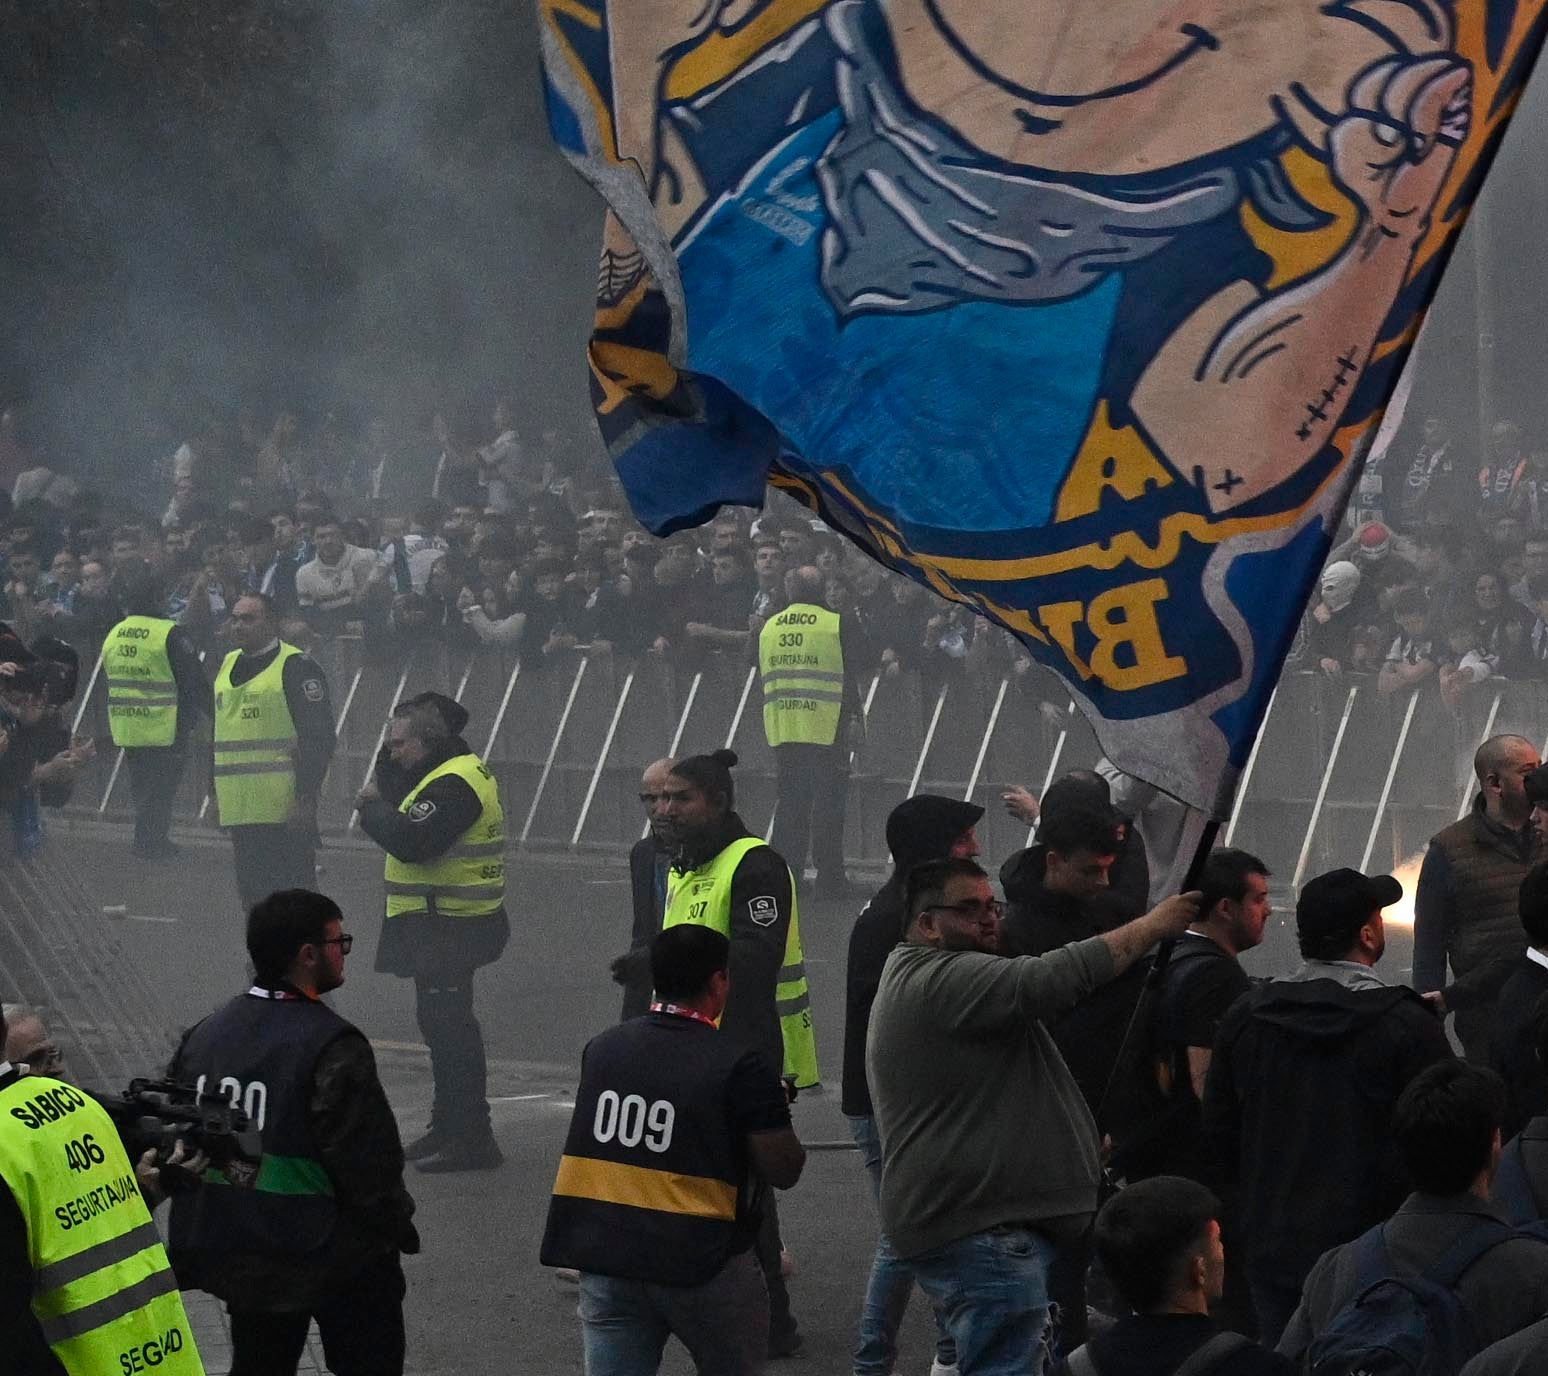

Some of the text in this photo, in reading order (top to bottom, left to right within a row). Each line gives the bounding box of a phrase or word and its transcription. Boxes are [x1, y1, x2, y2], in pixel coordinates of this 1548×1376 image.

[776, 613, 817, 626] SABICO
[778, 632, 804, 647] 330
[11, 1085, 86, 1130] SABICO
[593, 1090, 676, 1153] 009
[64, 1133, 105, 1174] 406
